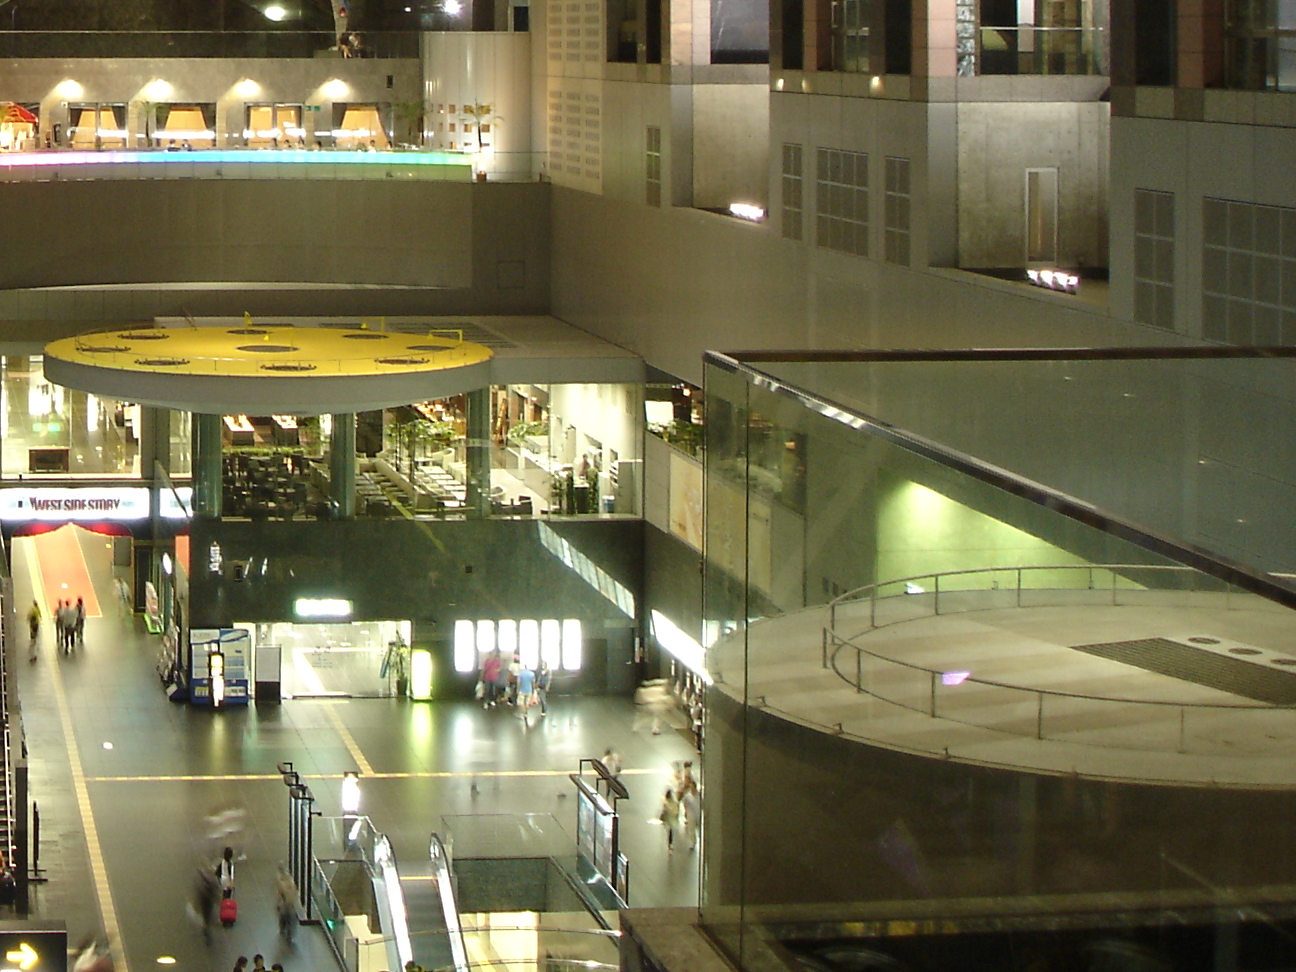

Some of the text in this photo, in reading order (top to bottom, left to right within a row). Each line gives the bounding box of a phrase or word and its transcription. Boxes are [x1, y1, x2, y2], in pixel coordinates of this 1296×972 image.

[29, 497, 62, 511] WEST
[64, 499, 86, 511] SIDE
[88, 499, 120, 511] STORY
